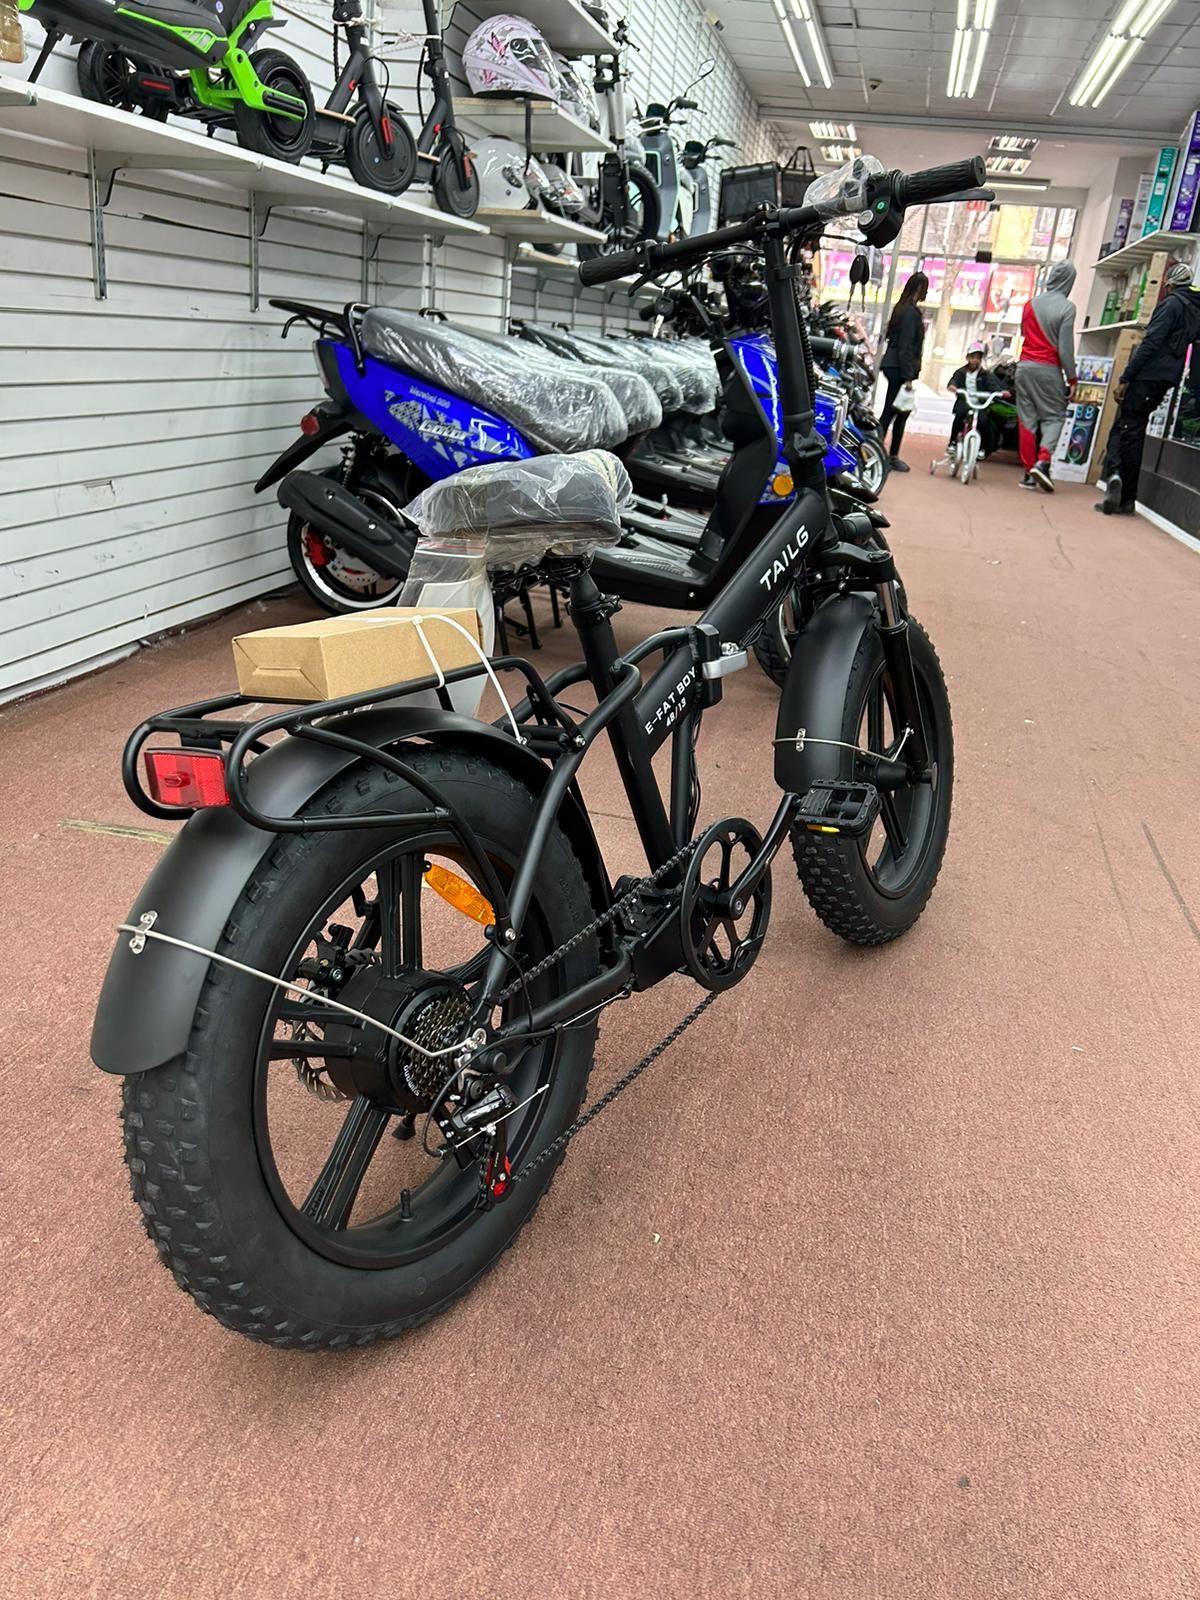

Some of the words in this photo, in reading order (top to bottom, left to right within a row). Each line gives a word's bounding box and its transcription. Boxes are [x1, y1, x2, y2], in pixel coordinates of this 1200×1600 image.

[759, 524, 809, 591] TAILG
[644, 691, 676, 735] E-FAT
[676, 665, 696, 696] BOY
